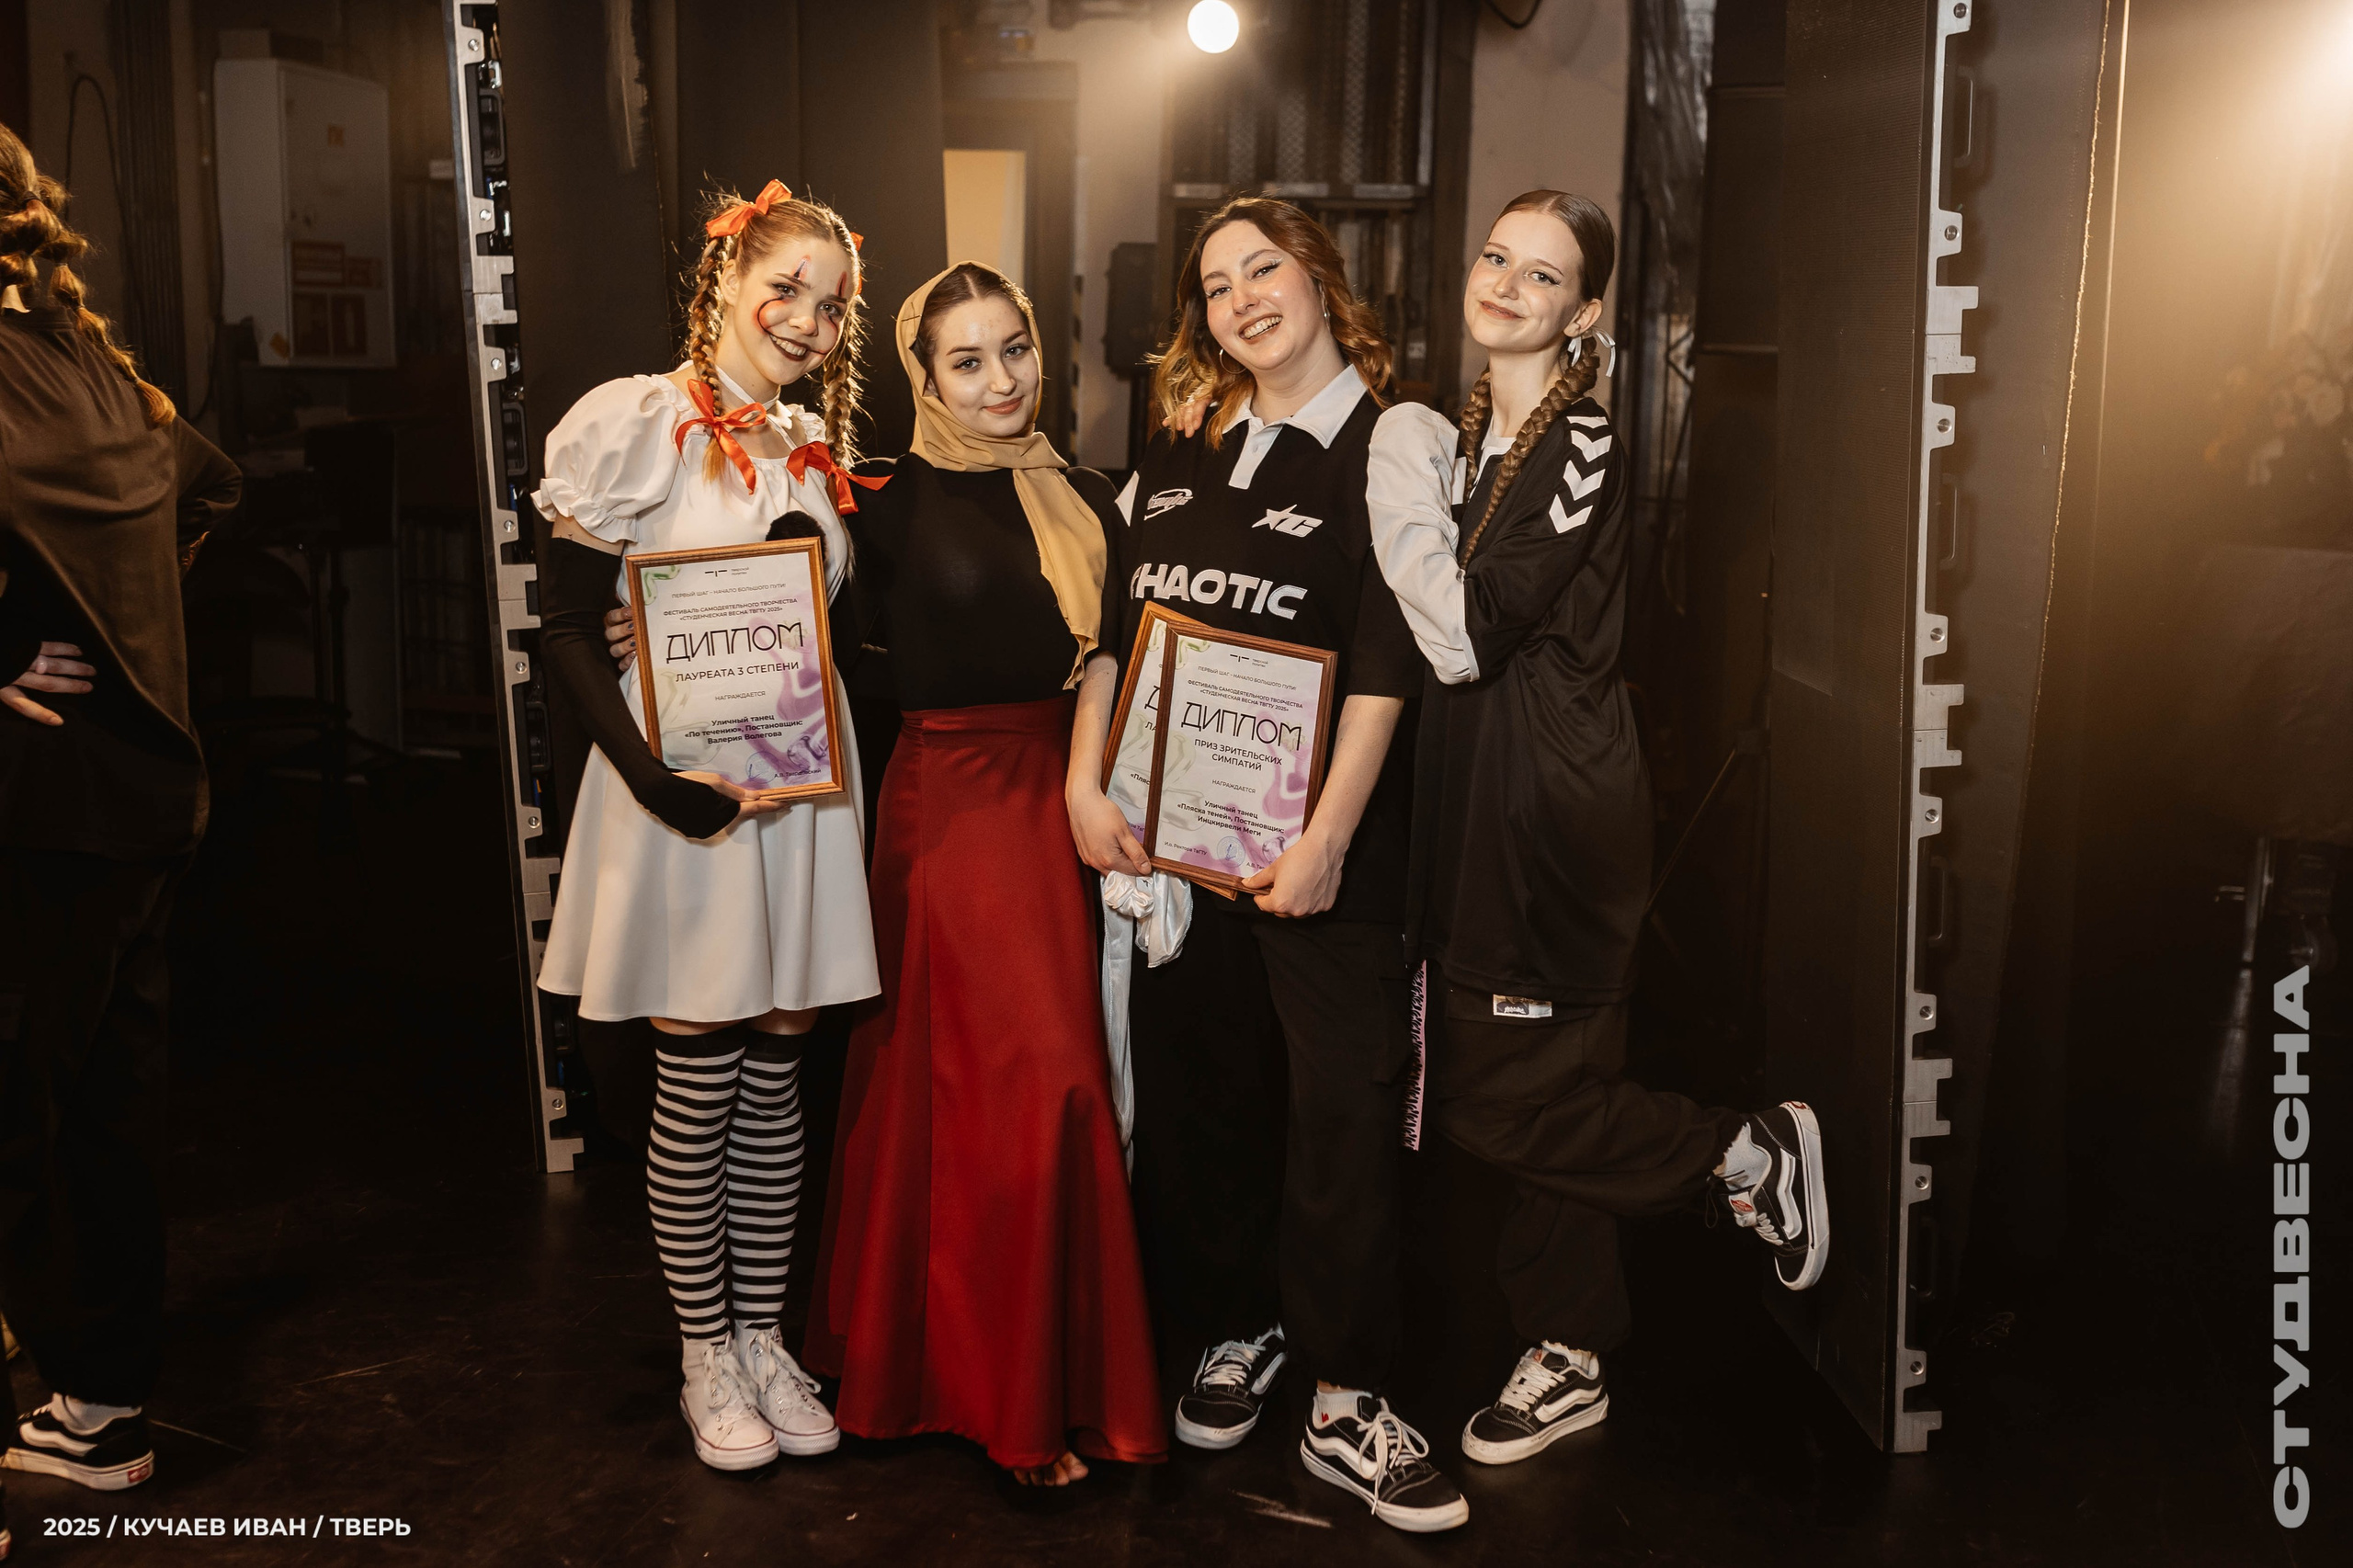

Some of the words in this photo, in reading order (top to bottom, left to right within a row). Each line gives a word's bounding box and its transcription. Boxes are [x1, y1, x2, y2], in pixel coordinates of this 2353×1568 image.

[672, 590, 696, 598] ПЕРВЫЙ
[664, 608, 699, 616] ФЕСТИВАЛЬ
[700, 601, 759, 612] САМОДЕЯТЕЛЬНОГО
[760, 598, 798, 607] ТВОРЧЕСТВА
[679, 612, 727, 621] «СТУДЕНЧЕСКАЯ
[666, 621, 803, 664] ДИПЛОМ
[676, 668, 735, 682] ЛАУРЕАТА
[737, 667, 744, 676] 3
[746, 662, 800, 675] СТЕПЕНИ
[1199, 665, 1218, 674] ПЕРВЫЙ
[1233, 674, 1253, 682] НАЧАЛО
[1254, 677, 1281, 688] БОЛЬШОГО
[715, 691, 766, 700] НАГРАЖДАЕТСЯ
[1188, 680, 1218, 690] ФЕСТИВАЛЬ
[1219, 686, 1270, 700] САМОДЕЯТЕЛЬНОГО
[1270, 697, 1303, 709] ТВОРЧЕСТВА
[1200, 689, 1241, 700] «СТУДЕНЧЕСКАЯ
[1241, 698, 1258, 706] ВЕСНА
[702, 726, 744, 736] течению»,
[745, 720, 803, 732] Постановщик:
[711, 716, 748, 726] Уличный
[751, 714, 774, 722] танец
[1181, 701, 1302, 751] ДИПЛОМ
[708, 735, 743, 744] Валерия
[745, 732, 782, 740] Волегова
[1195, 739, 1218, 751] ПРИЗ
[1220, 744, 1282, 766] ЗРИТЕЛЬСКИХ
[1211, 753, 1262, 771] СИМПАТИЙ
[1131, 773, 1151, 786] «Пляс
[1212, 779, 1256, 794] НАГРАЖДАЕТСЯ
[1176, 803, 1206, 814] «Пляска
[1207, 809, 1233, 822] теней»,
[1234, 815, 1284, 834] Постановщик:
[1204, 801, 1236, 814] Уличный
[1237, 809, 1258, 820] танец
[1198, 816, 1242, 833] Инцкирвели
[1243, 826, 1261, 837] Меги
